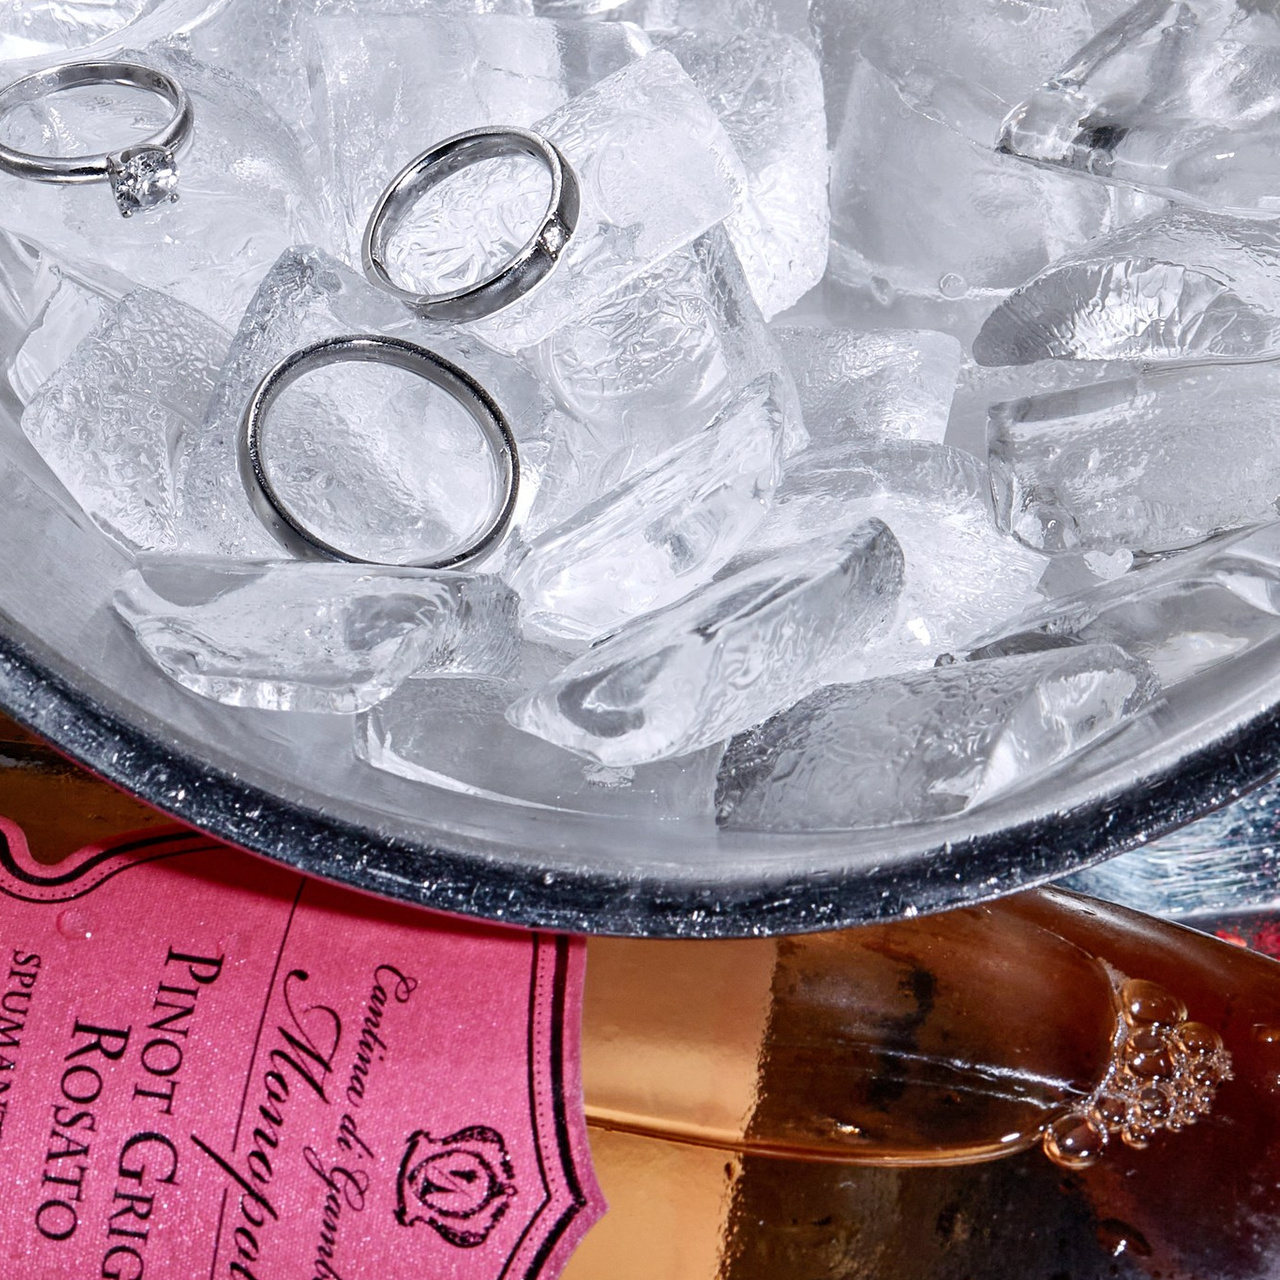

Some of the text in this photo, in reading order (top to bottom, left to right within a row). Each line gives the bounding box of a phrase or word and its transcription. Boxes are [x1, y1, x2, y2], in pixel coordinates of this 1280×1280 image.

[131, 945, 225, 1117] PINOT
[346, 963, 418, 1108] Cantina
[34, 1015, 132, 1242] ROSATO
[337, 1114, 375, 1159] di
